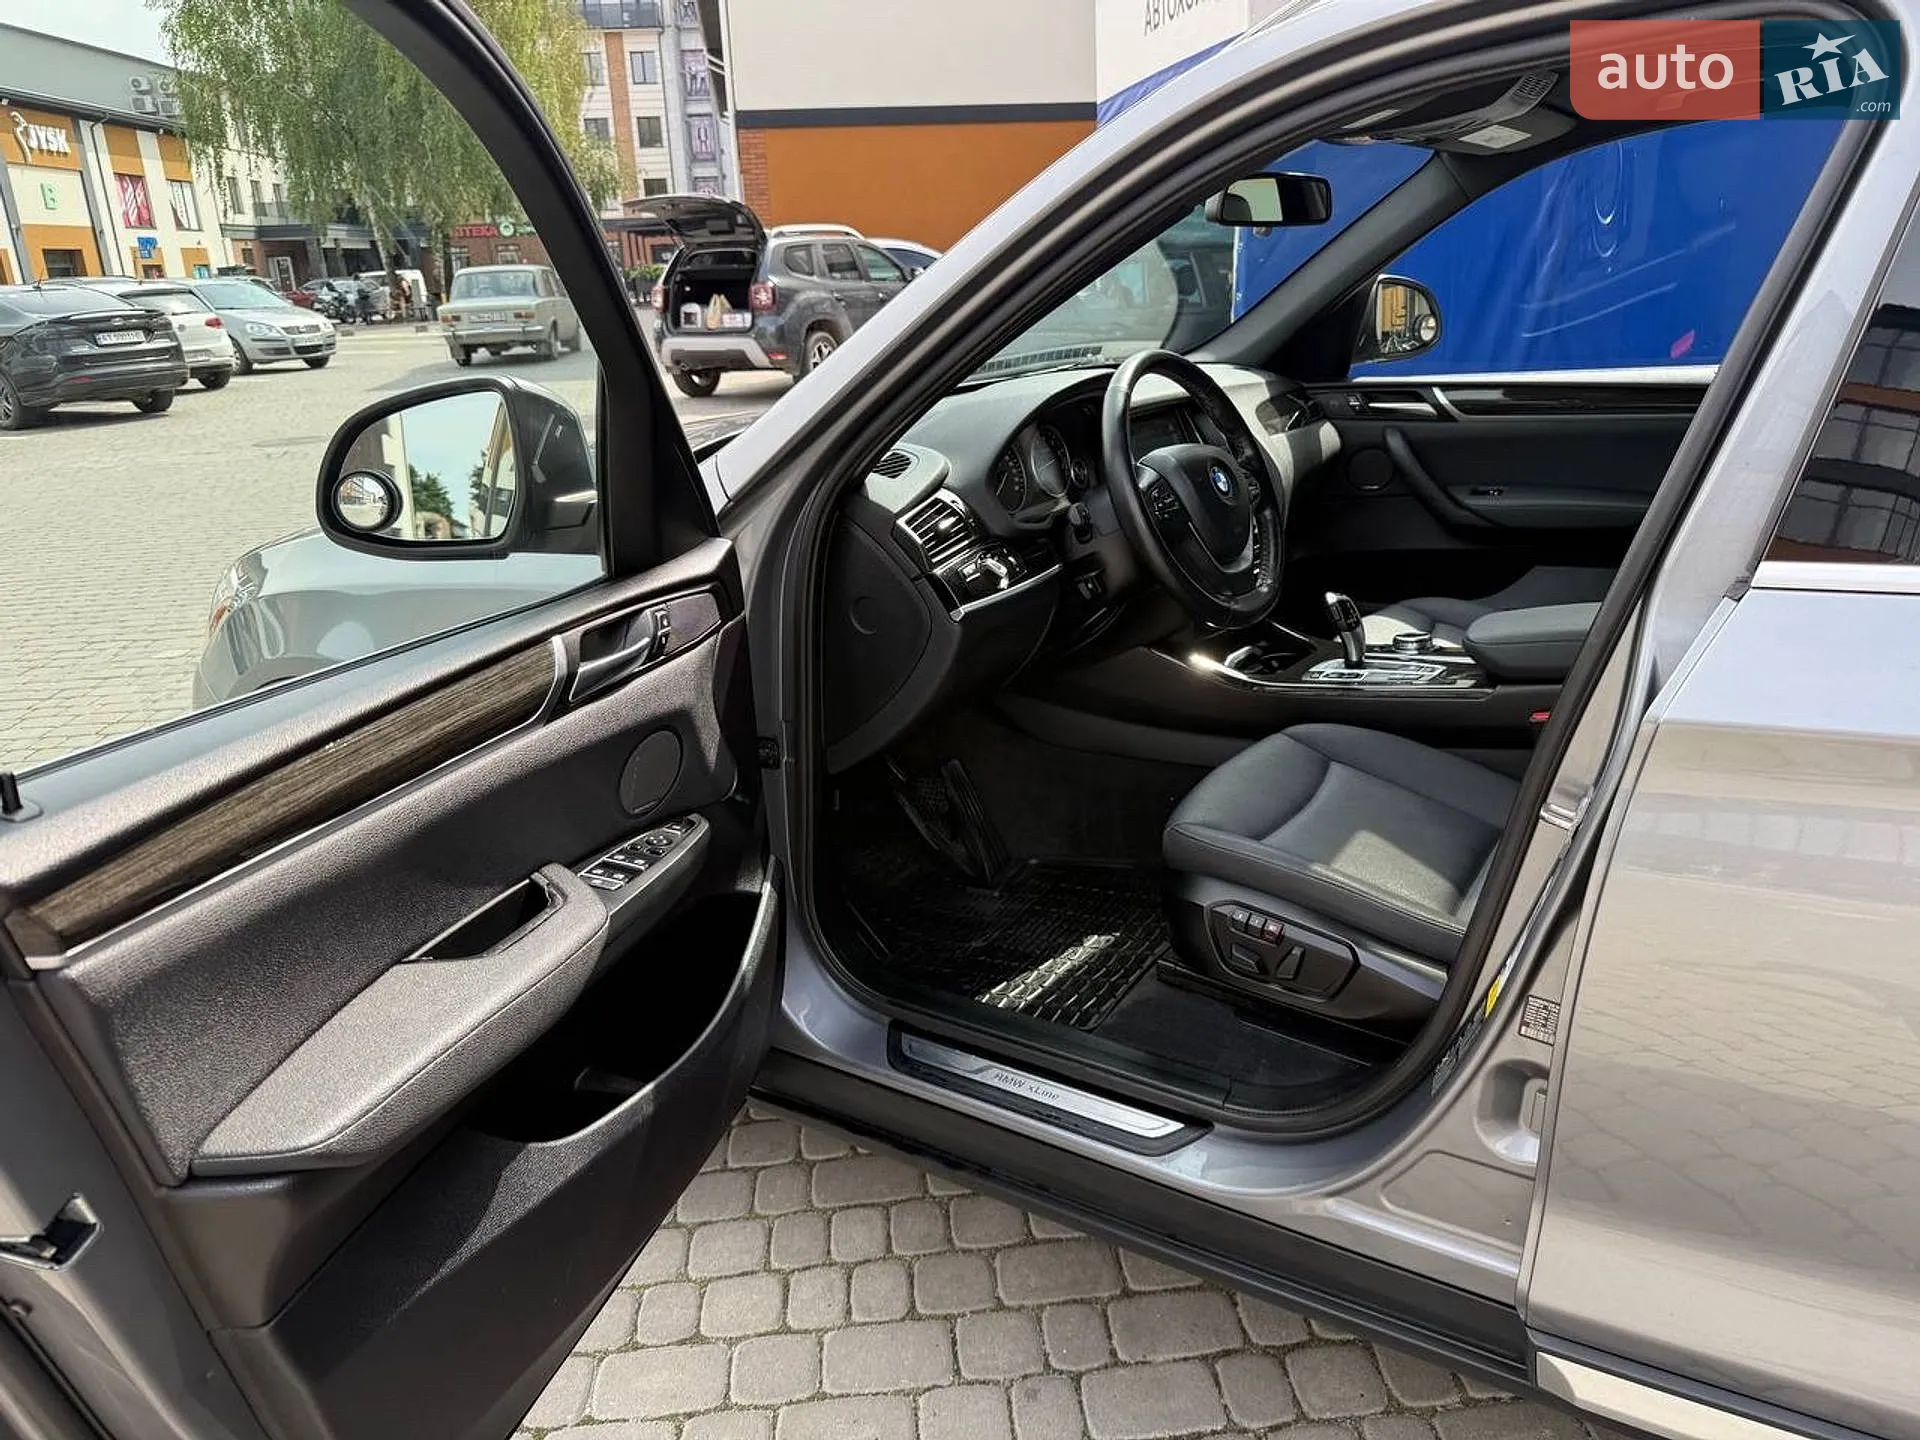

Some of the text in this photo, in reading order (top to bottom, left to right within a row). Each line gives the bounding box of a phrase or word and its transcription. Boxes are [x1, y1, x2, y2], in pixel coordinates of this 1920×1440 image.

[1143, 0, 1199, 37] АВТО
[28, 123, 72, 154] JYSK
[451, 224, 499, 238] ПТЕКА
